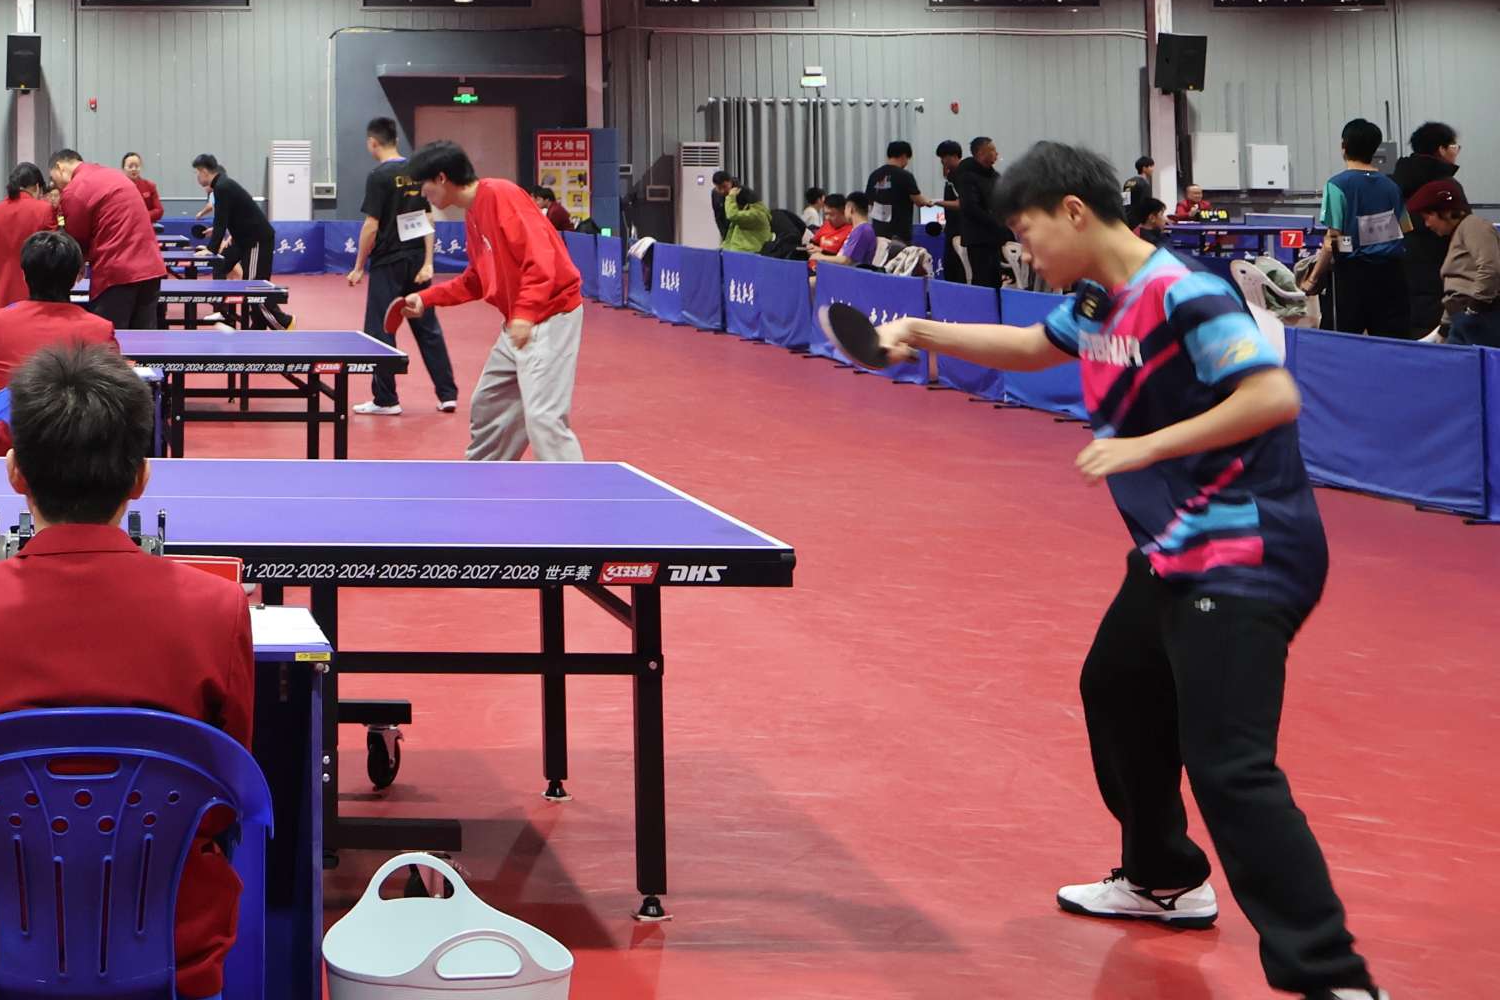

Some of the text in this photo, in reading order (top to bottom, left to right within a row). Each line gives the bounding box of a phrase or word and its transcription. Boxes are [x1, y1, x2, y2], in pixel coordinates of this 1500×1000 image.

[273, 239, 307, 254] 乒乓
[1287, 233, 1296, 245] 7
[347, 363, 377, 373] DHS
[545, 564, 592, 580] 世乒赛
[668, 565, 728, 582] DHS
